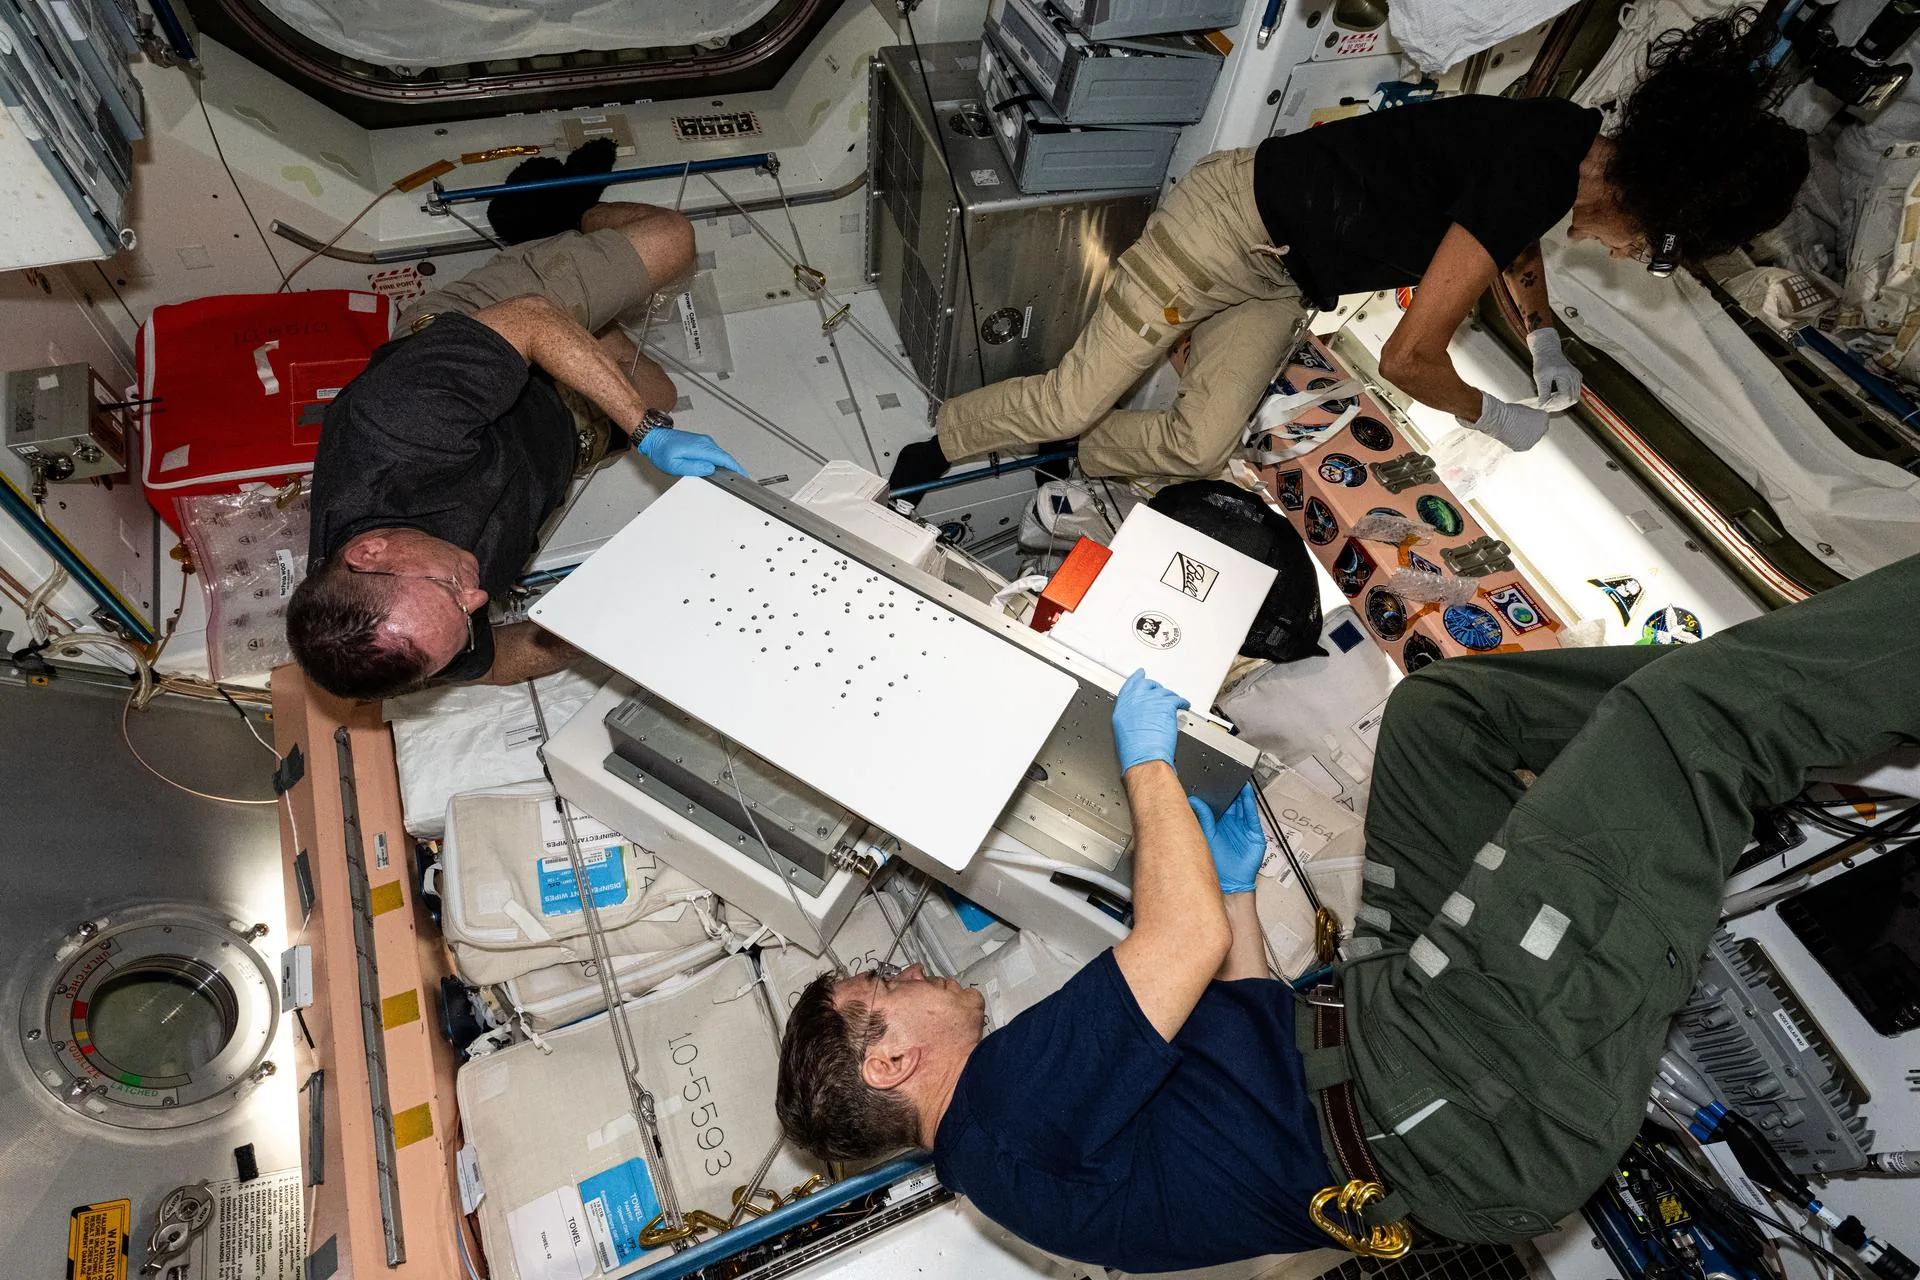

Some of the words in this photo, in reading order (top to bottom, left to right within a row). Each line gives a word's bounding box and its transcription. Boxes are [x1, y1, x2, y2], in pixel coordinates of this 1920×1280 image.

[1662, 232, 1676, 253] PETZL
[396, 280, 414, 288] PORT
[683, 292, 692, 310] Power
[688, 311, 697, 329] Cable
[1298, 352, 1318, 368] 46
[1185, 559, 1204, 597] Ball
[1683, 614, 1697, 627] 56
[1160, 636, 1177, 647] PANDA
[543, 891, 568, 903] WIPES
[65, 951, 110, 999] UNLATCHED
[65, 1039, 101, 1080] EQUALIZE
[110, 1083, 158, 1096] LATCHED
[196, 1206, 208, 1222] LATCH
[623, 1199, 633, 1221] PANTRY
[629, 1191, 644, 1222] TOWEL
[99, 1237, 105, 1245] TO
[539, 1231, 550, 1250] TOWEL
[567, 1216, 581, 1247] TOWEL
[92, 1238, 100, 1275] UNLATCHING
[104, 1228, 116, 1280] WARNING
